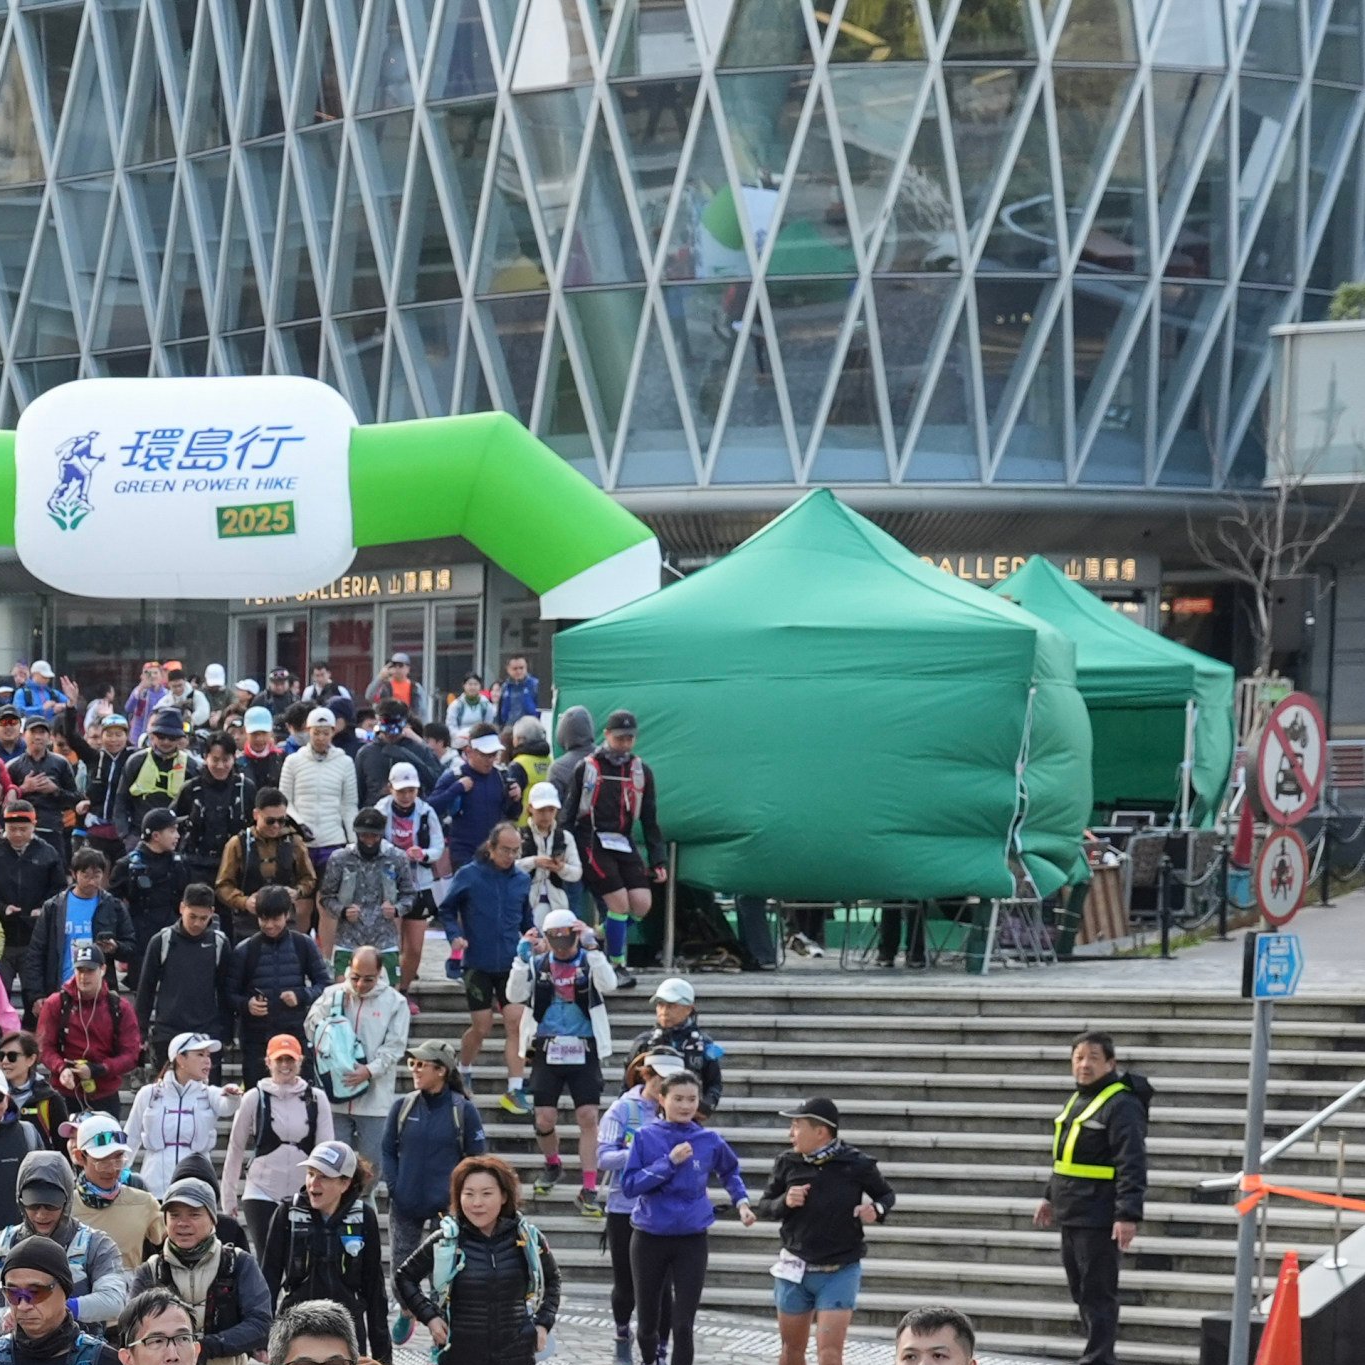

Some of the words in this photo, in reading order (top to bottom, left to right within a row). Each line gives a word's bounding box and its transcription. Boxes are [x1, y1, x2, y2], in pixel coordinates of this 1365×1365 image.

[120, 426, 305, 472] 環島行
[114, 478, 175, 495] GREEN
[182, 477, 248, 493] POWER
[255, 476, 298, 491] HIKE
[221, 504, 290, 535] 2025
